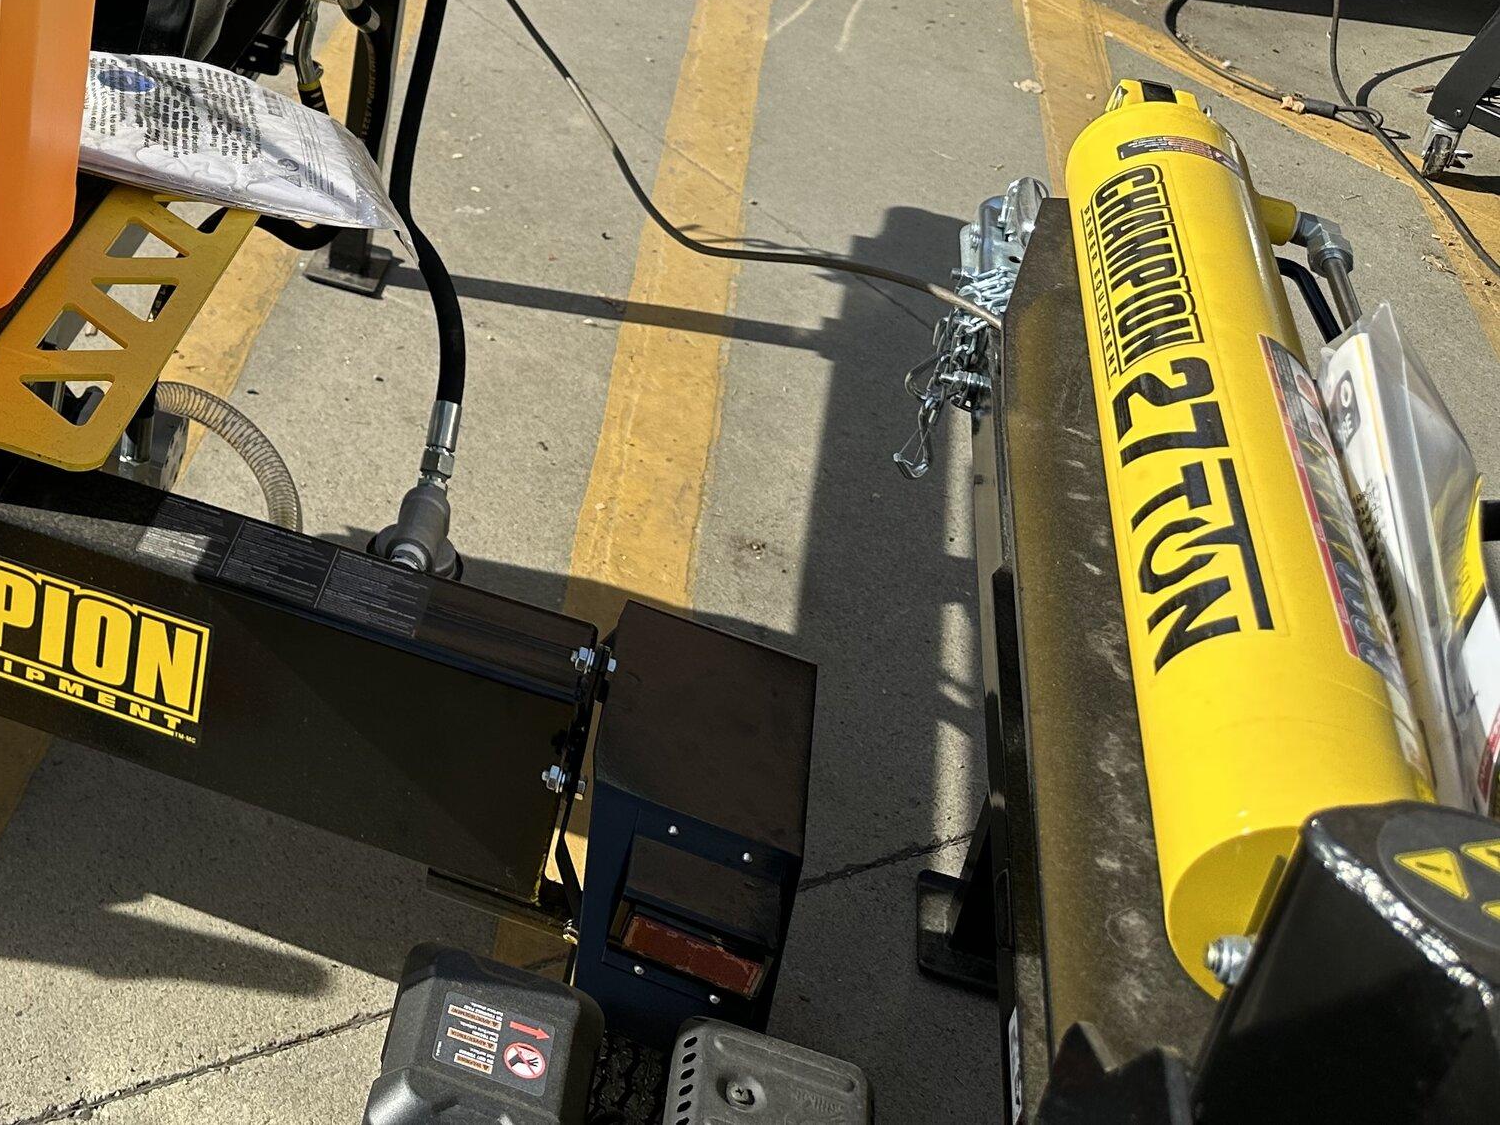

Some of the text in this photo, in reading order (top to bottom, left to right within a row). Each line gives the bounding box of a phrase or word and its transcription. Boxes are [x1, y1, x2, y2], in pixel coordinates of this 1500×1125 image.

[1080, 210, 1119, 378] POWER EQUIPMENT
[1097, 167, 1198, 366] CHAMPION
[1112, 355, 1275, 673] 27 TON
